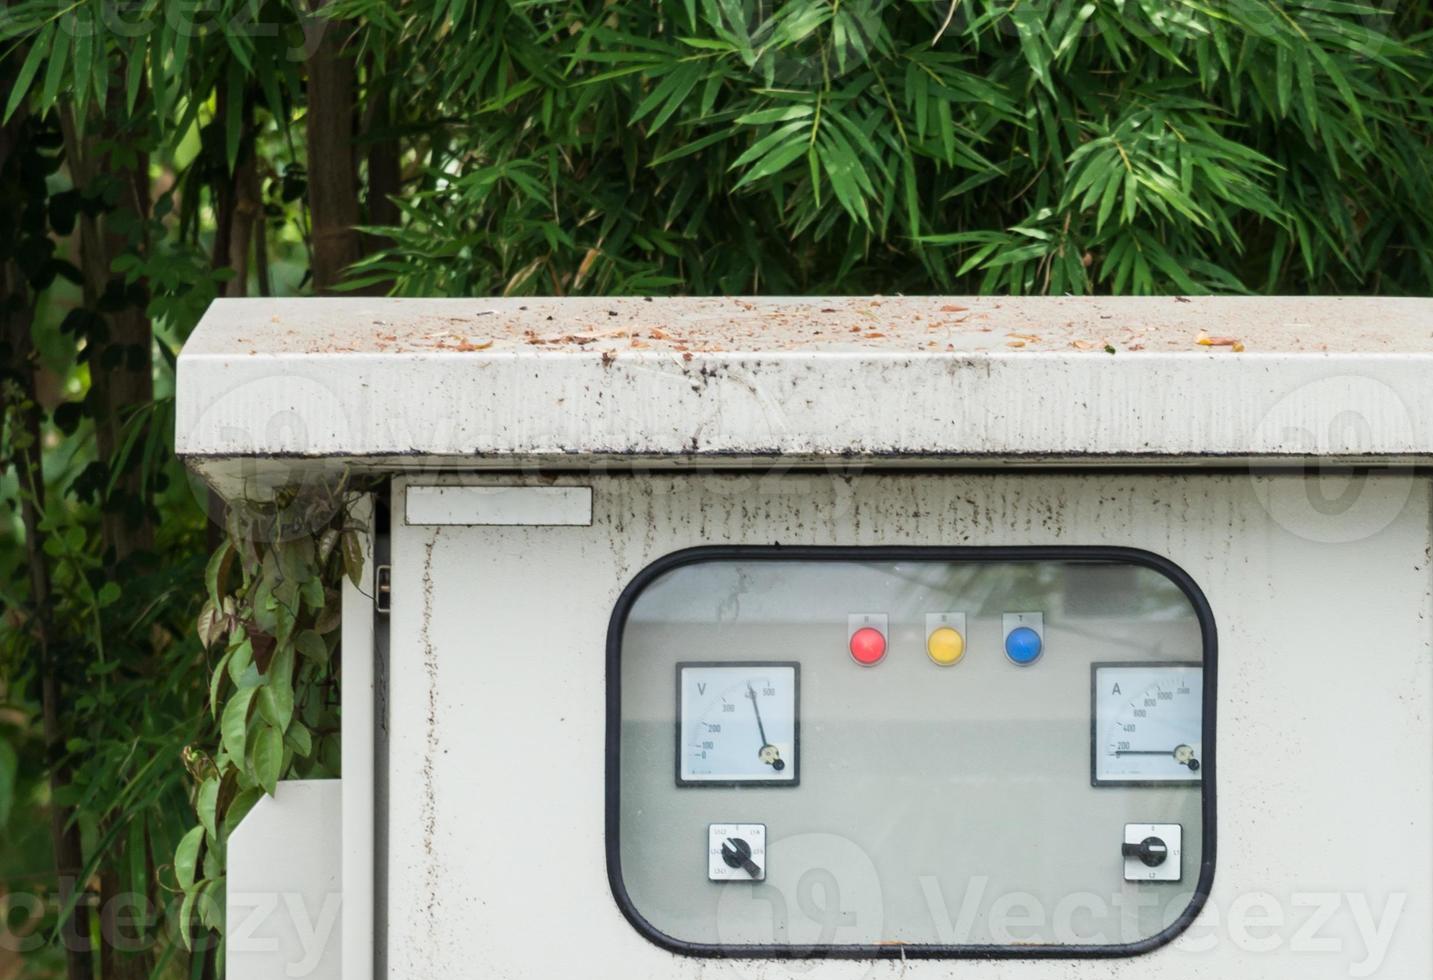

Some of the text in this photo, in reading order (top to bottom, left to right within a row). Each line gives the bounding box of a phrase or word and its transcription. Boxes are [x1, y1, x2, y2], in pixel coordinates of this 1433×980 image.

[697, 682, 707, 696] V
[1111, 682, 1122, 696] A
[1123, 724, 1136, 733] 400
